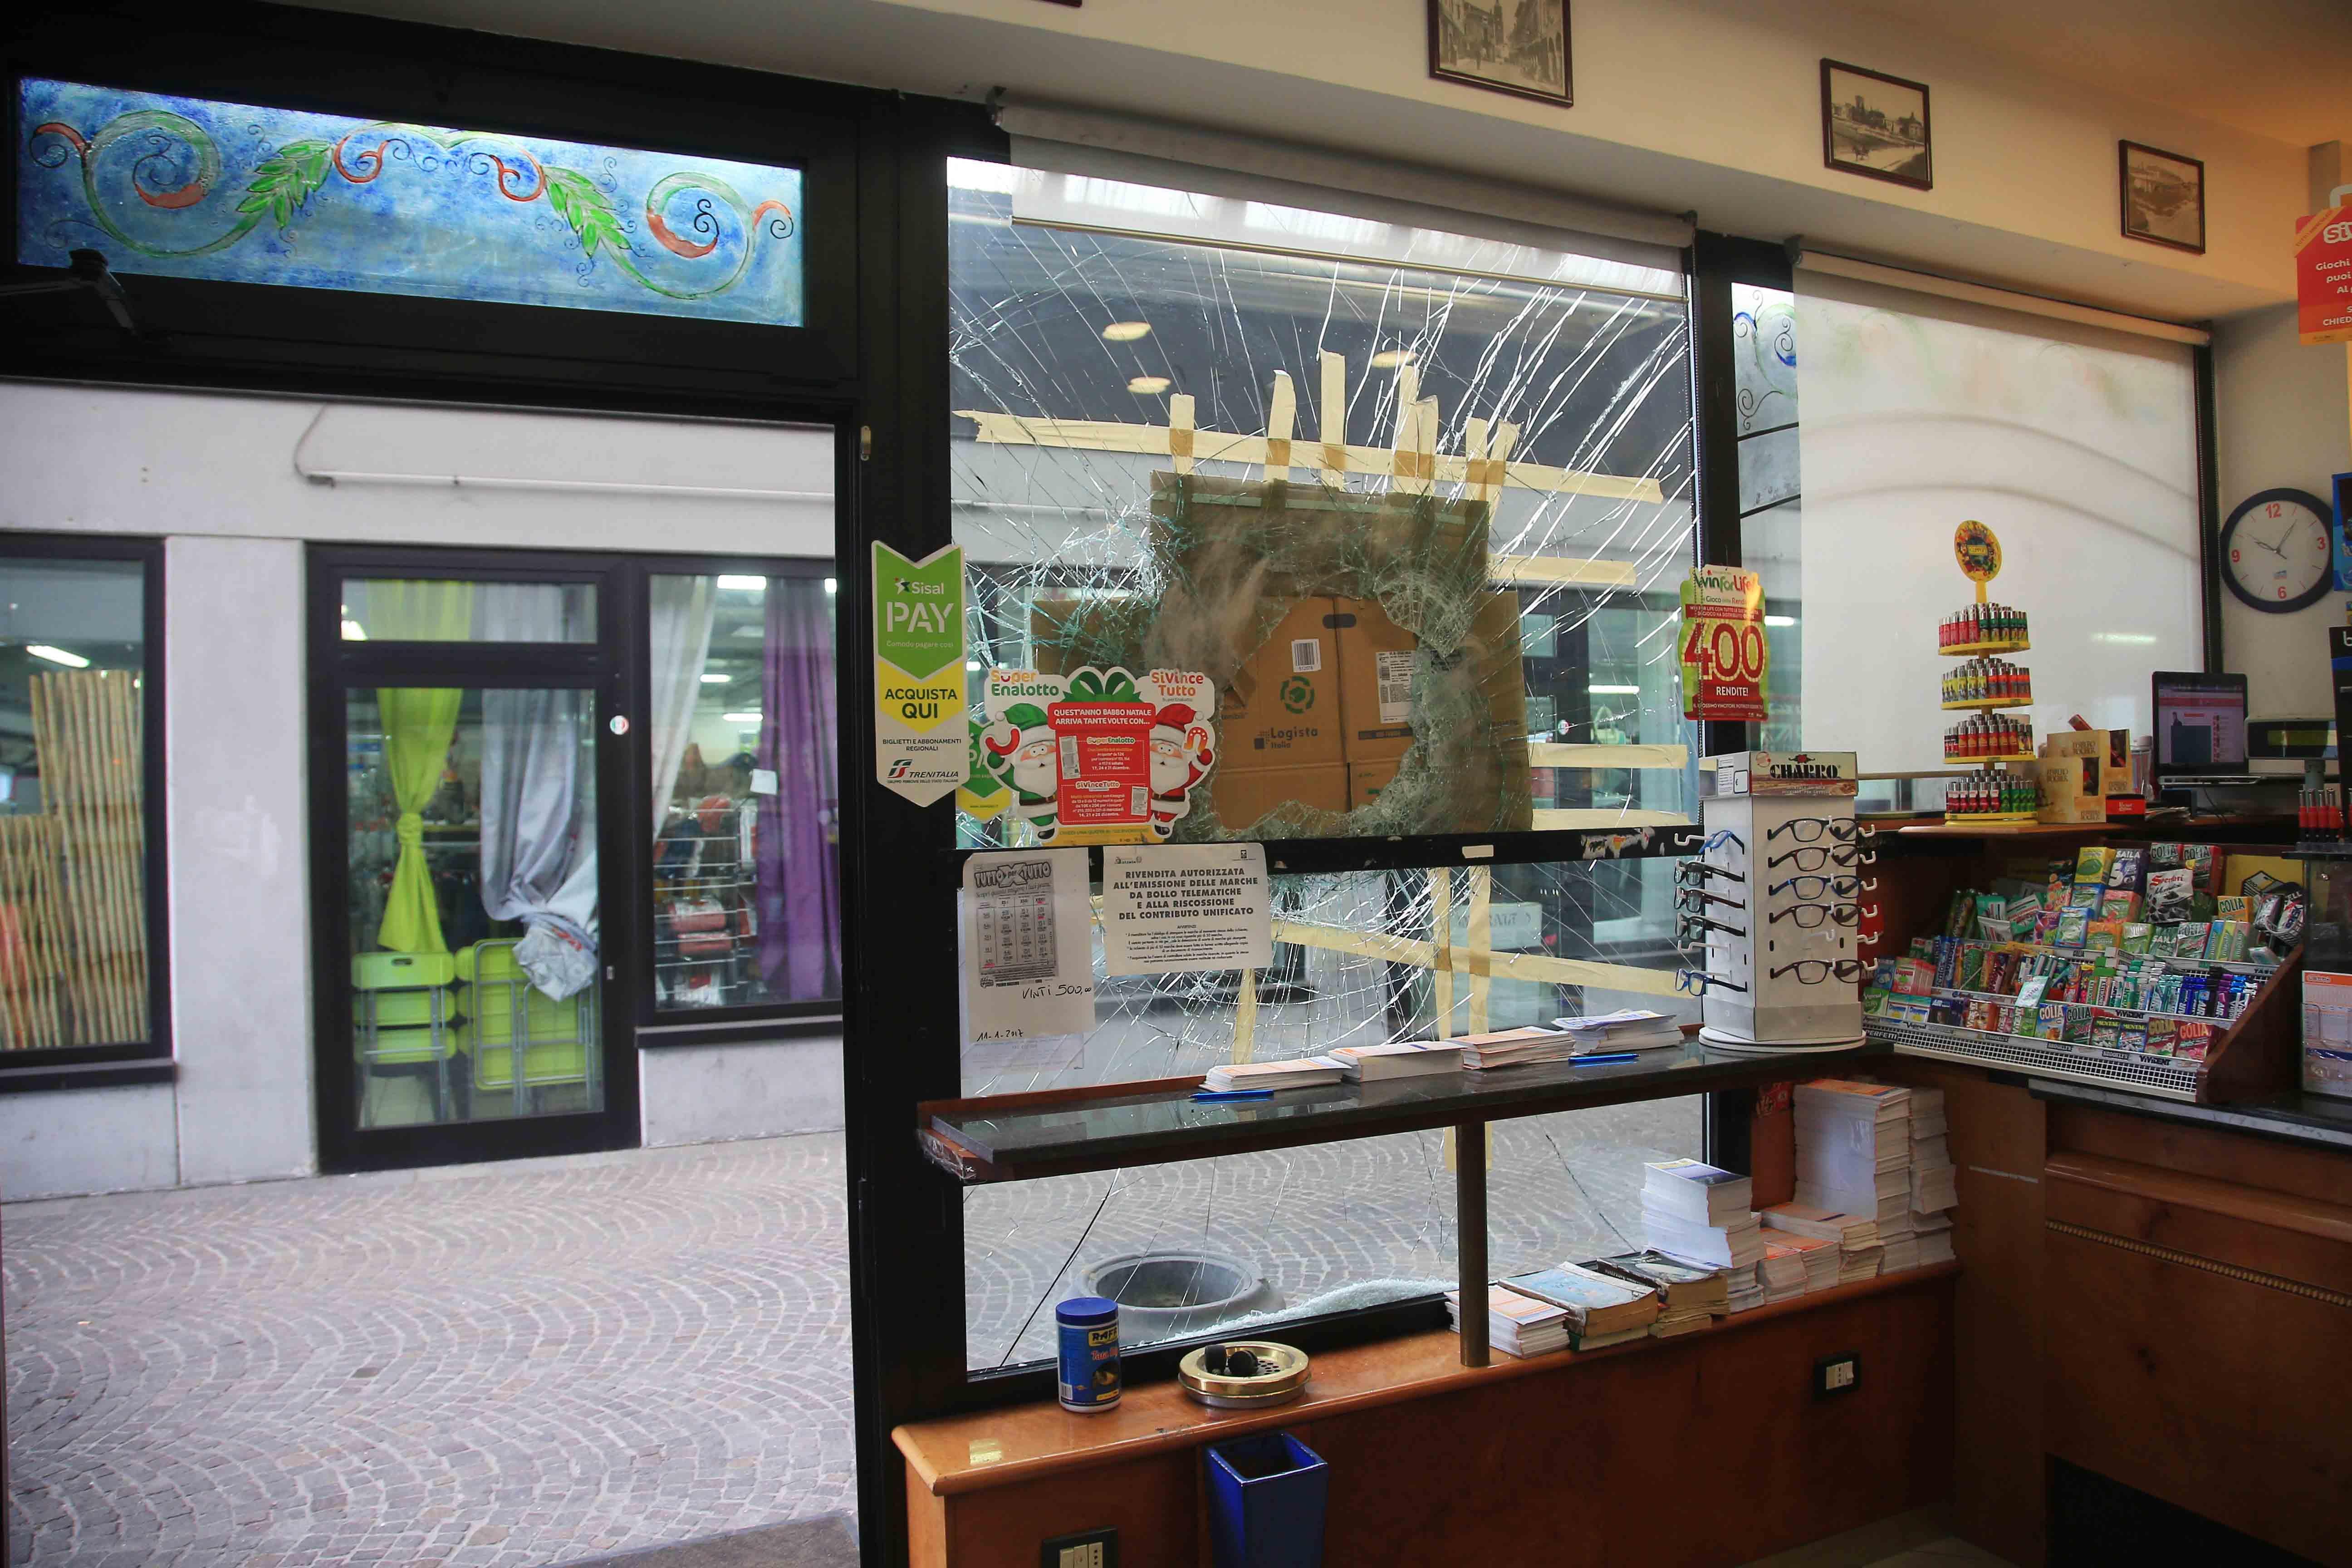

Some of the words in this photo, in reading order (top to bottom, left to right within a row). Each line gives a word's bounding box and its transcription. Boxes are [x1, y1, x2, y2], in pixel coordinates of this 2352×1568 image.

[2316, 258, 2350, 270] Giochi
[2326, 272, 2352, 283] puoi
[2265, 503, 2282, 518] 12
[2317, 537, 2326, 550] 3
[2231, 549, 2240, 563] 9
[911, 581, 944, 595] Sisal
[2277, 586, 2287, 599] 6
[887, 602, 954, 633] PAY
[1683, 622, 1764, 680] 400
[990, 671, 1037, 685] Super
[1151, 671, 1204, 684] SiVince
[885, 689, 957, 700] ACQUISTA
[991, 683, 1059, 696] Enalotto
[1158, 684, 1196, 697] Tutto
[1716, 686, 1749, 696] RENDITE!
[902, 703, 938, 719] QUI
[1054, 708, 1102, 716] QUEST'ANNO
[2116, 850, 2141, 859] SAILA
[974, 870, 1004, 888] TUTTO
[1022, 862, 1052, 880] TUTTO
[1125, 870, 1176, 879] RIVENDITA
[1180, 867, 1245, 877] AUTORIZZATA
[1113, 879, 1186, 889] ALL'EMISSIONE
[1219, 877, 1258, 886] MARCHE
[1181, 888, 1242, 897] TELEMATICHE
[1146, 901, 1169, 909] ALLA
[1173, 898, 1235, 908] RISCOSSIONE
[2219, 897, 2245, 913] GOLIA
[1139, 910, 1199, 920] CONTRIBUTO
[1203, 907, 1254, 916] UNIFICATO
[2039, 1004, 2064, 1020] GOLIA
[2067, 1006, 2091, 1021] GOLIA
[2180, 1023, 2209, 1039] GOLIA
